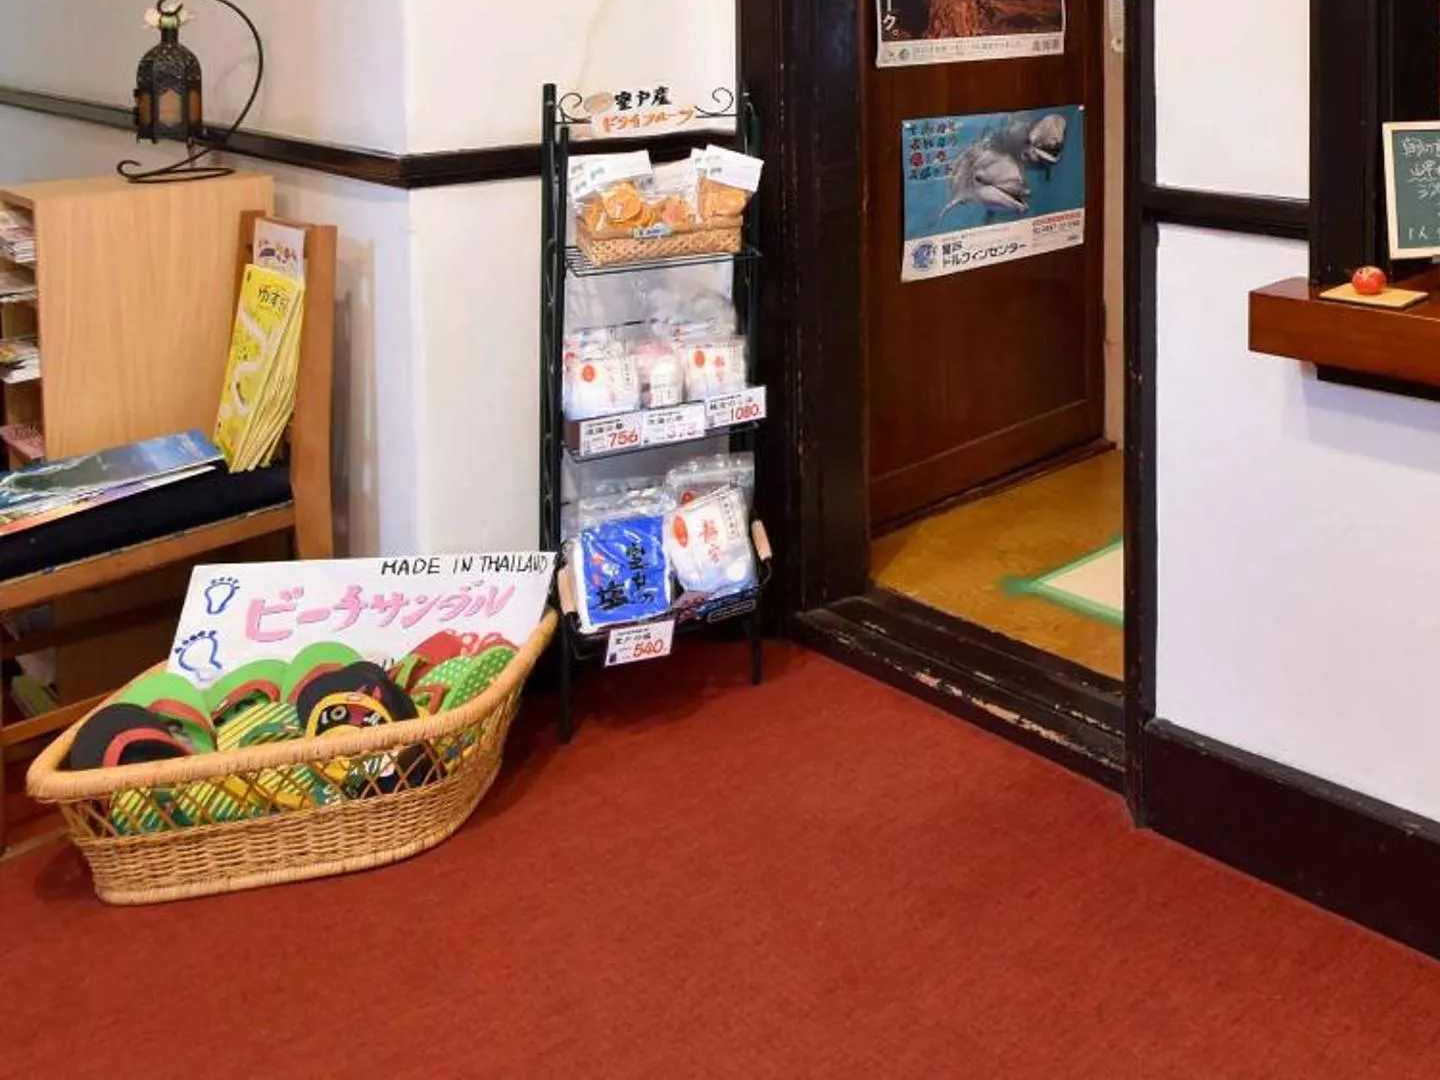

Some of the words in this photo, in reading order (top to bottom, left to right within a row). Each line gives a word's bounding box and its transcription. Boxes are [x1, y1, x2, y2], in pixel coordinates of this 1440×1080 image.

[942, 242, 1027, 268] ドルフィンセンター
[607, 430, 639, 449] 756
[380, 556, 442, 577] MADE
[452, 556, 474, 575] IN
[479, 554, 549, 575] THAILAND
[245, 580, 516, 643] ビーチサンダル
[632, 639, 665, 658] 540
